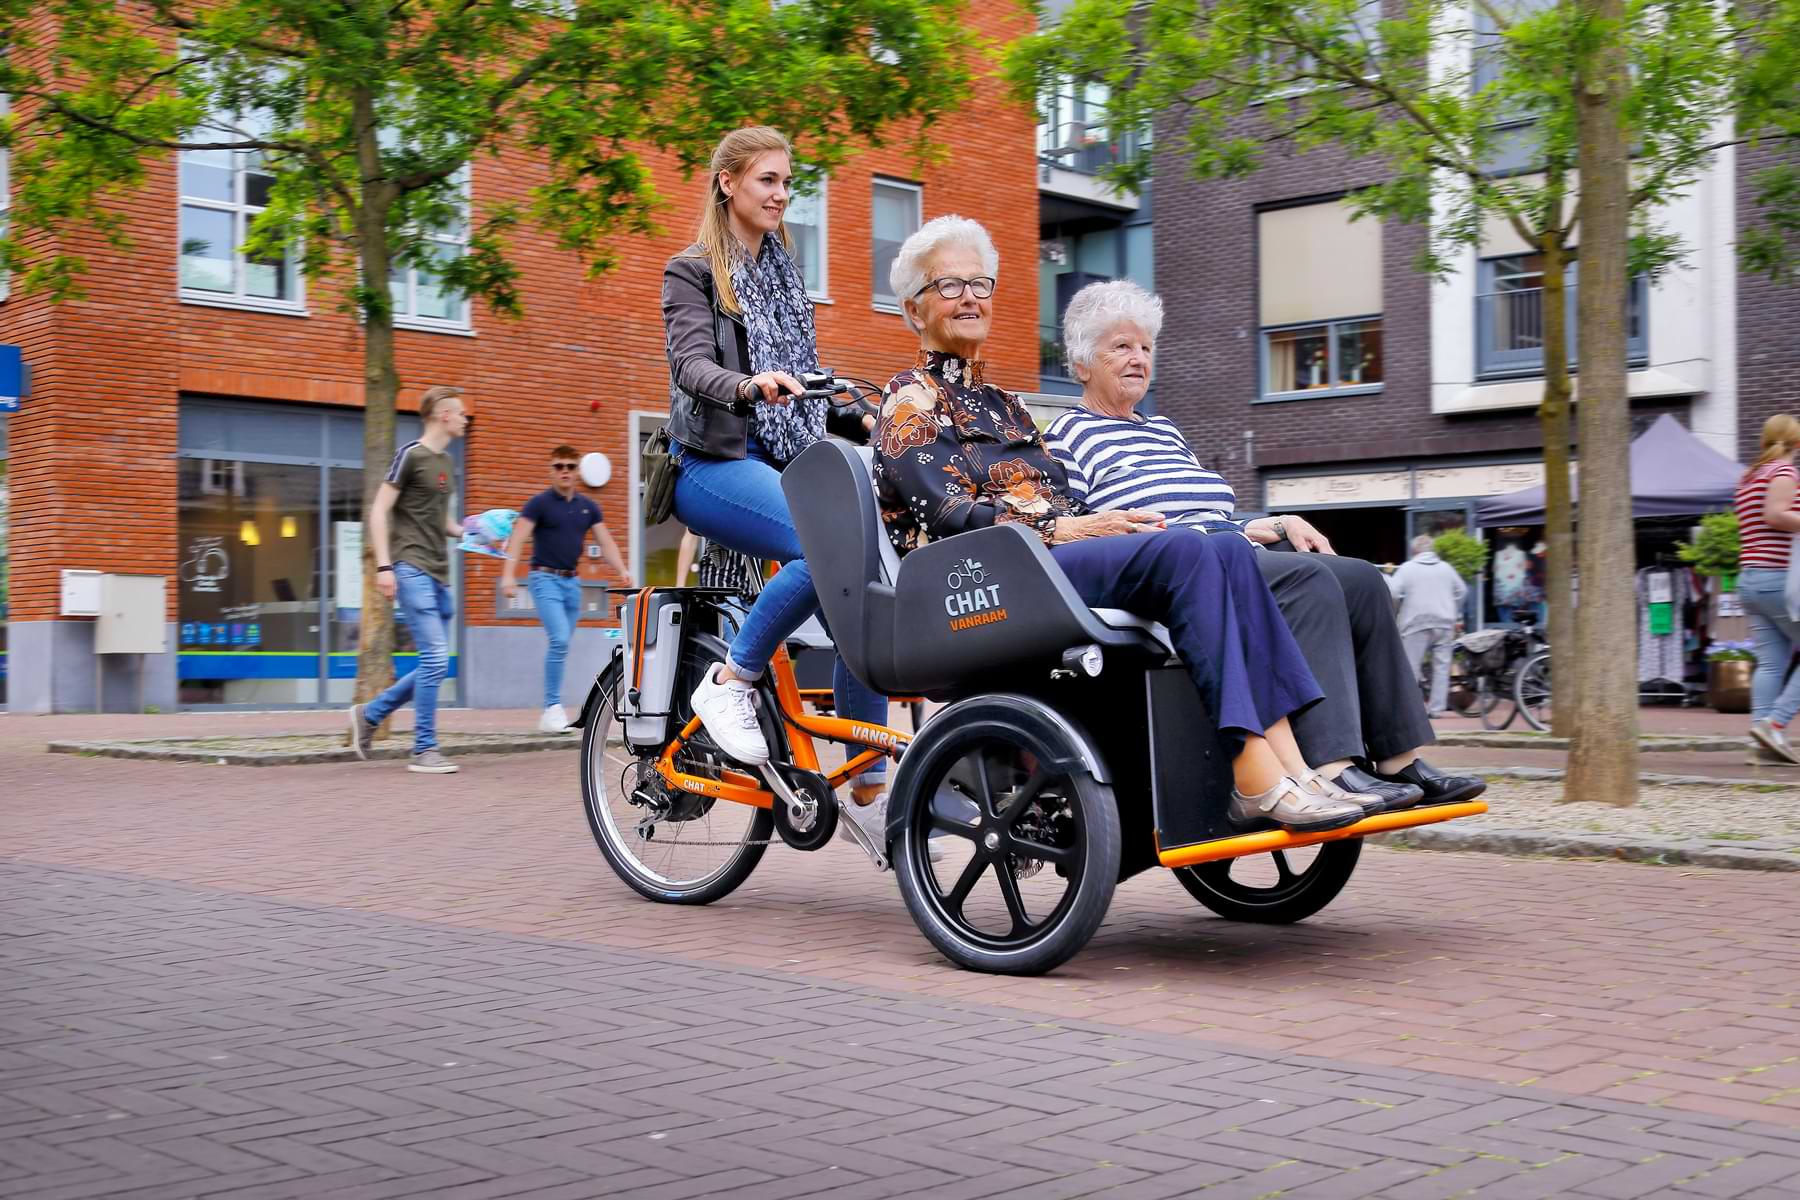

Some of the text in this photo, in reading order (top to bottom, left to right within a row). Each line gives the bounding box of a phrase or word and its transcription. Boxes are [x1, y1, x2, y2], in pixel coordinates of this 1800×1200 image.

[945, 584, 1000, 616] CHAT
[950, 608, 1008, 631] VANRAAM
[684, 779, 705, 792] CHAT
